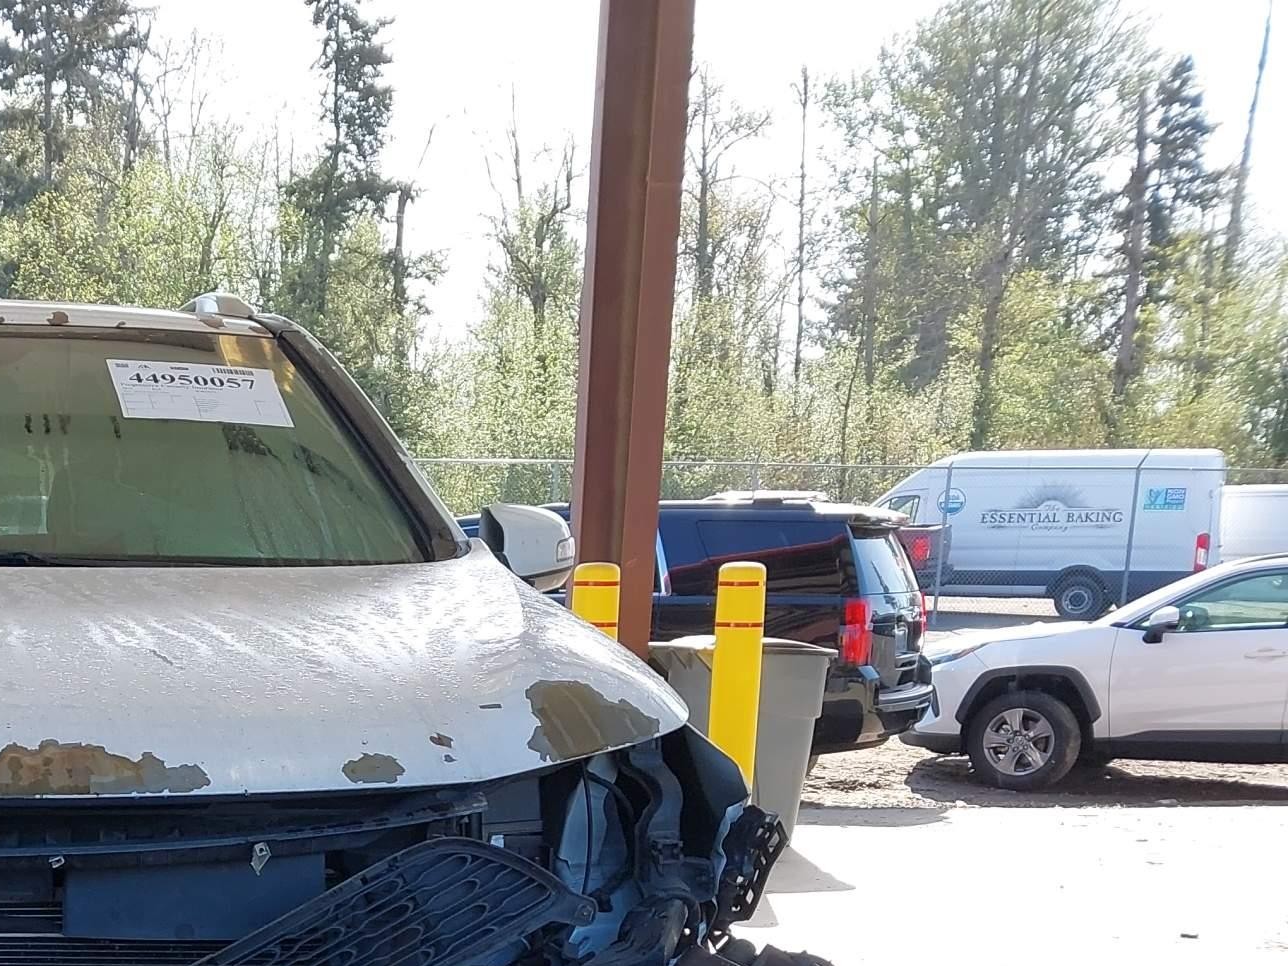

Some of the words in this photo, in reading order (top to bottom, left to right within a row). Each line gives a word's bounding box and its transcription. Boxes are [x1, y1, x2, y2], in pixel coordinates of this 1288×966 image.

[129, 373, 255, 390] 44950057
[980, 512, 1060, 524] ESSENTIAL
[1066, 511, 1123, 523] BAKING
